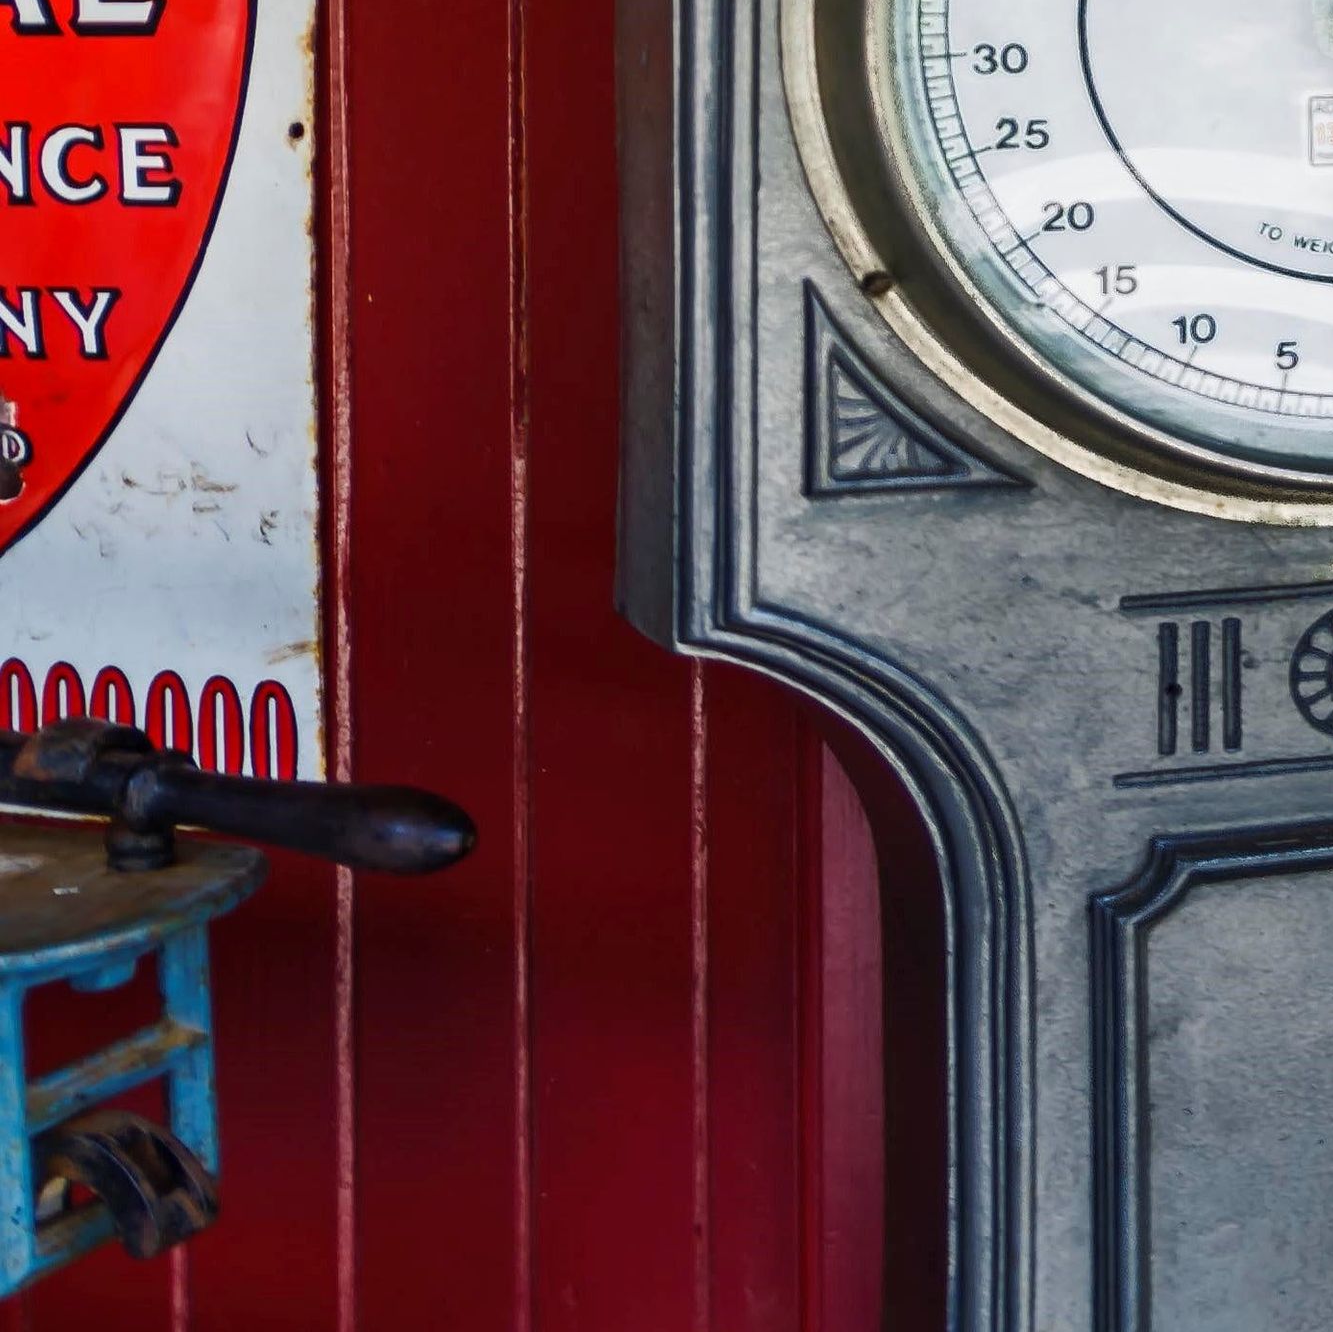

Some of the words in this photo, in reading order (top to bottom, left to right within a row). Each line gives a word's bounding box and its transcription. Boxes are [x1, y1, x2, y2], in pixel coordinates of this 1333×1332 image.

[972, 42, 1029, 75] 30
[994, 118, 1050, 150] 25
[1041, 200, 1095, 232] 20
[1257, 221, 1284, 242] TO
[1093, 265, 1138, 296] 15
[1171, 314, 1217, 344] 10
[1276, 341, 1299, 371] 5
